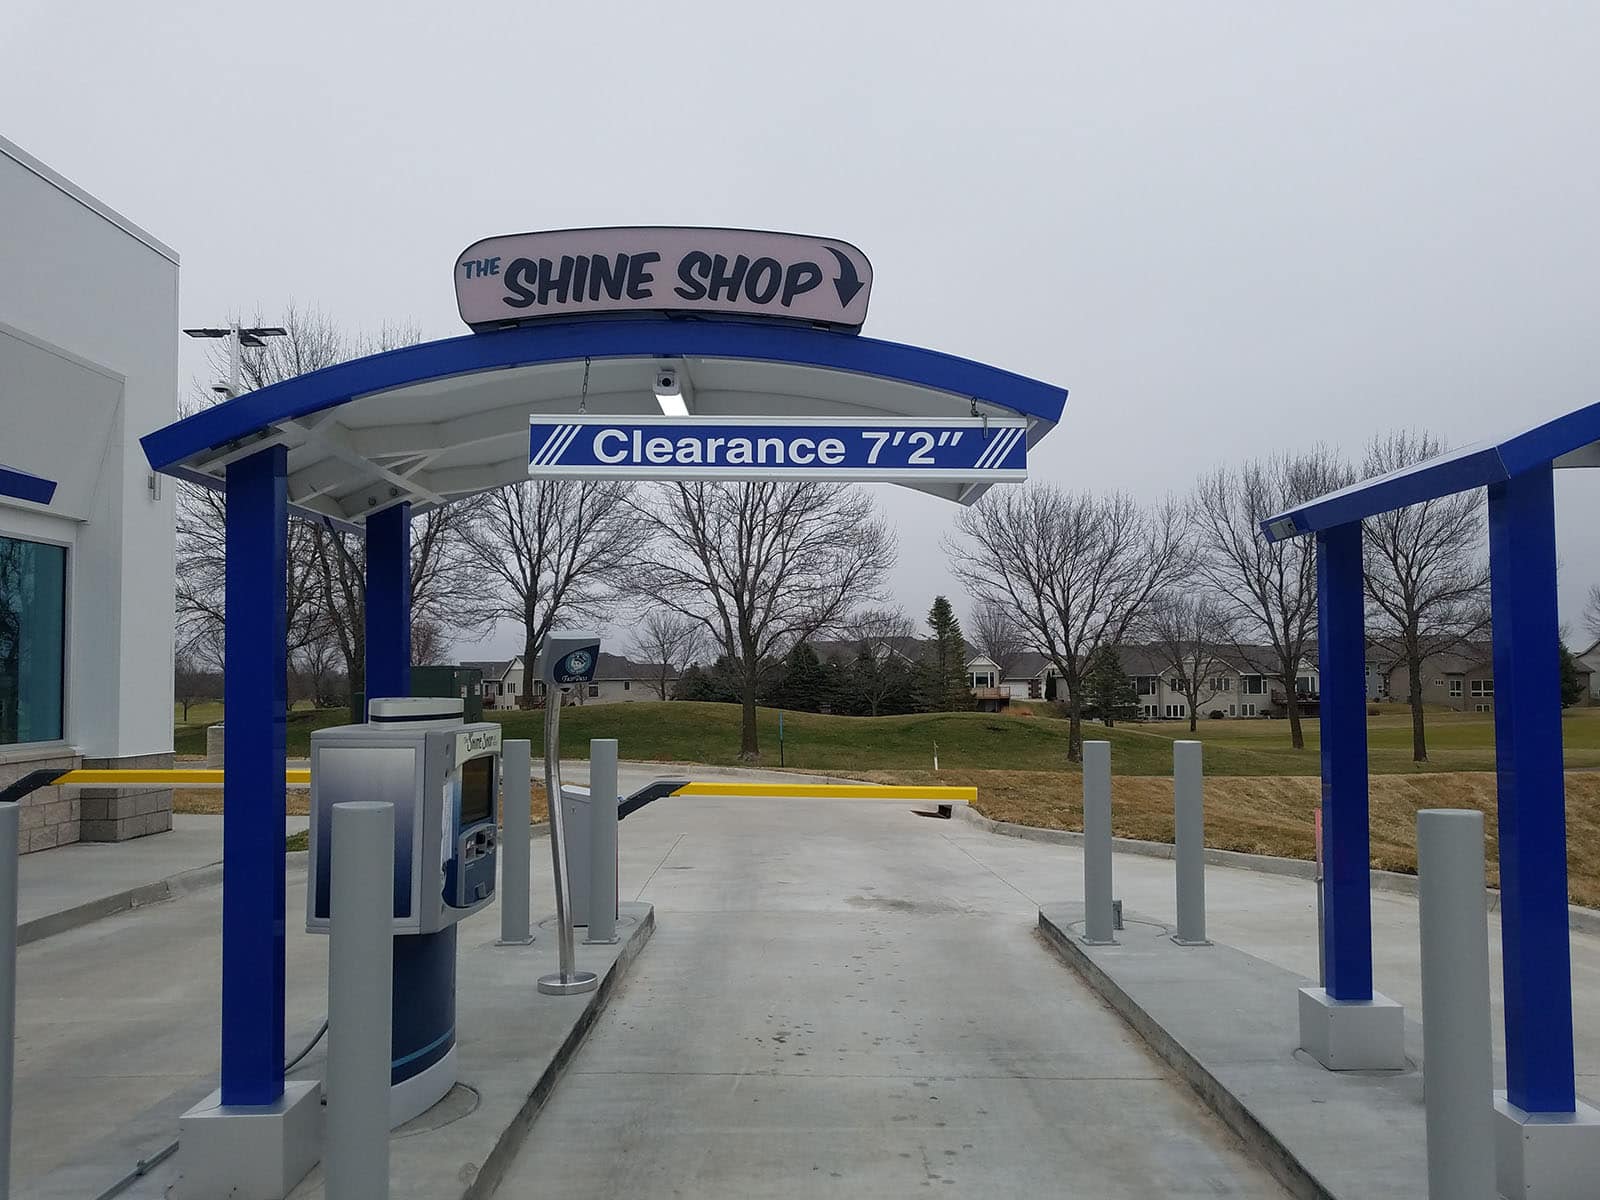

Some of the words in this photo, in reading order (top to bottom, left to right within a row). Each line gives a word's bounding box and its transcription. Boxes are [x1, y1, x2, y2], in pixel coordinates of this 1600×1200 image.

[462, 257, 501, 280] THE
[502, 251, 662, 308] SHINE
[674, 250, 824, 308] SHOP
[593, 429, 846, 465] Clearance
